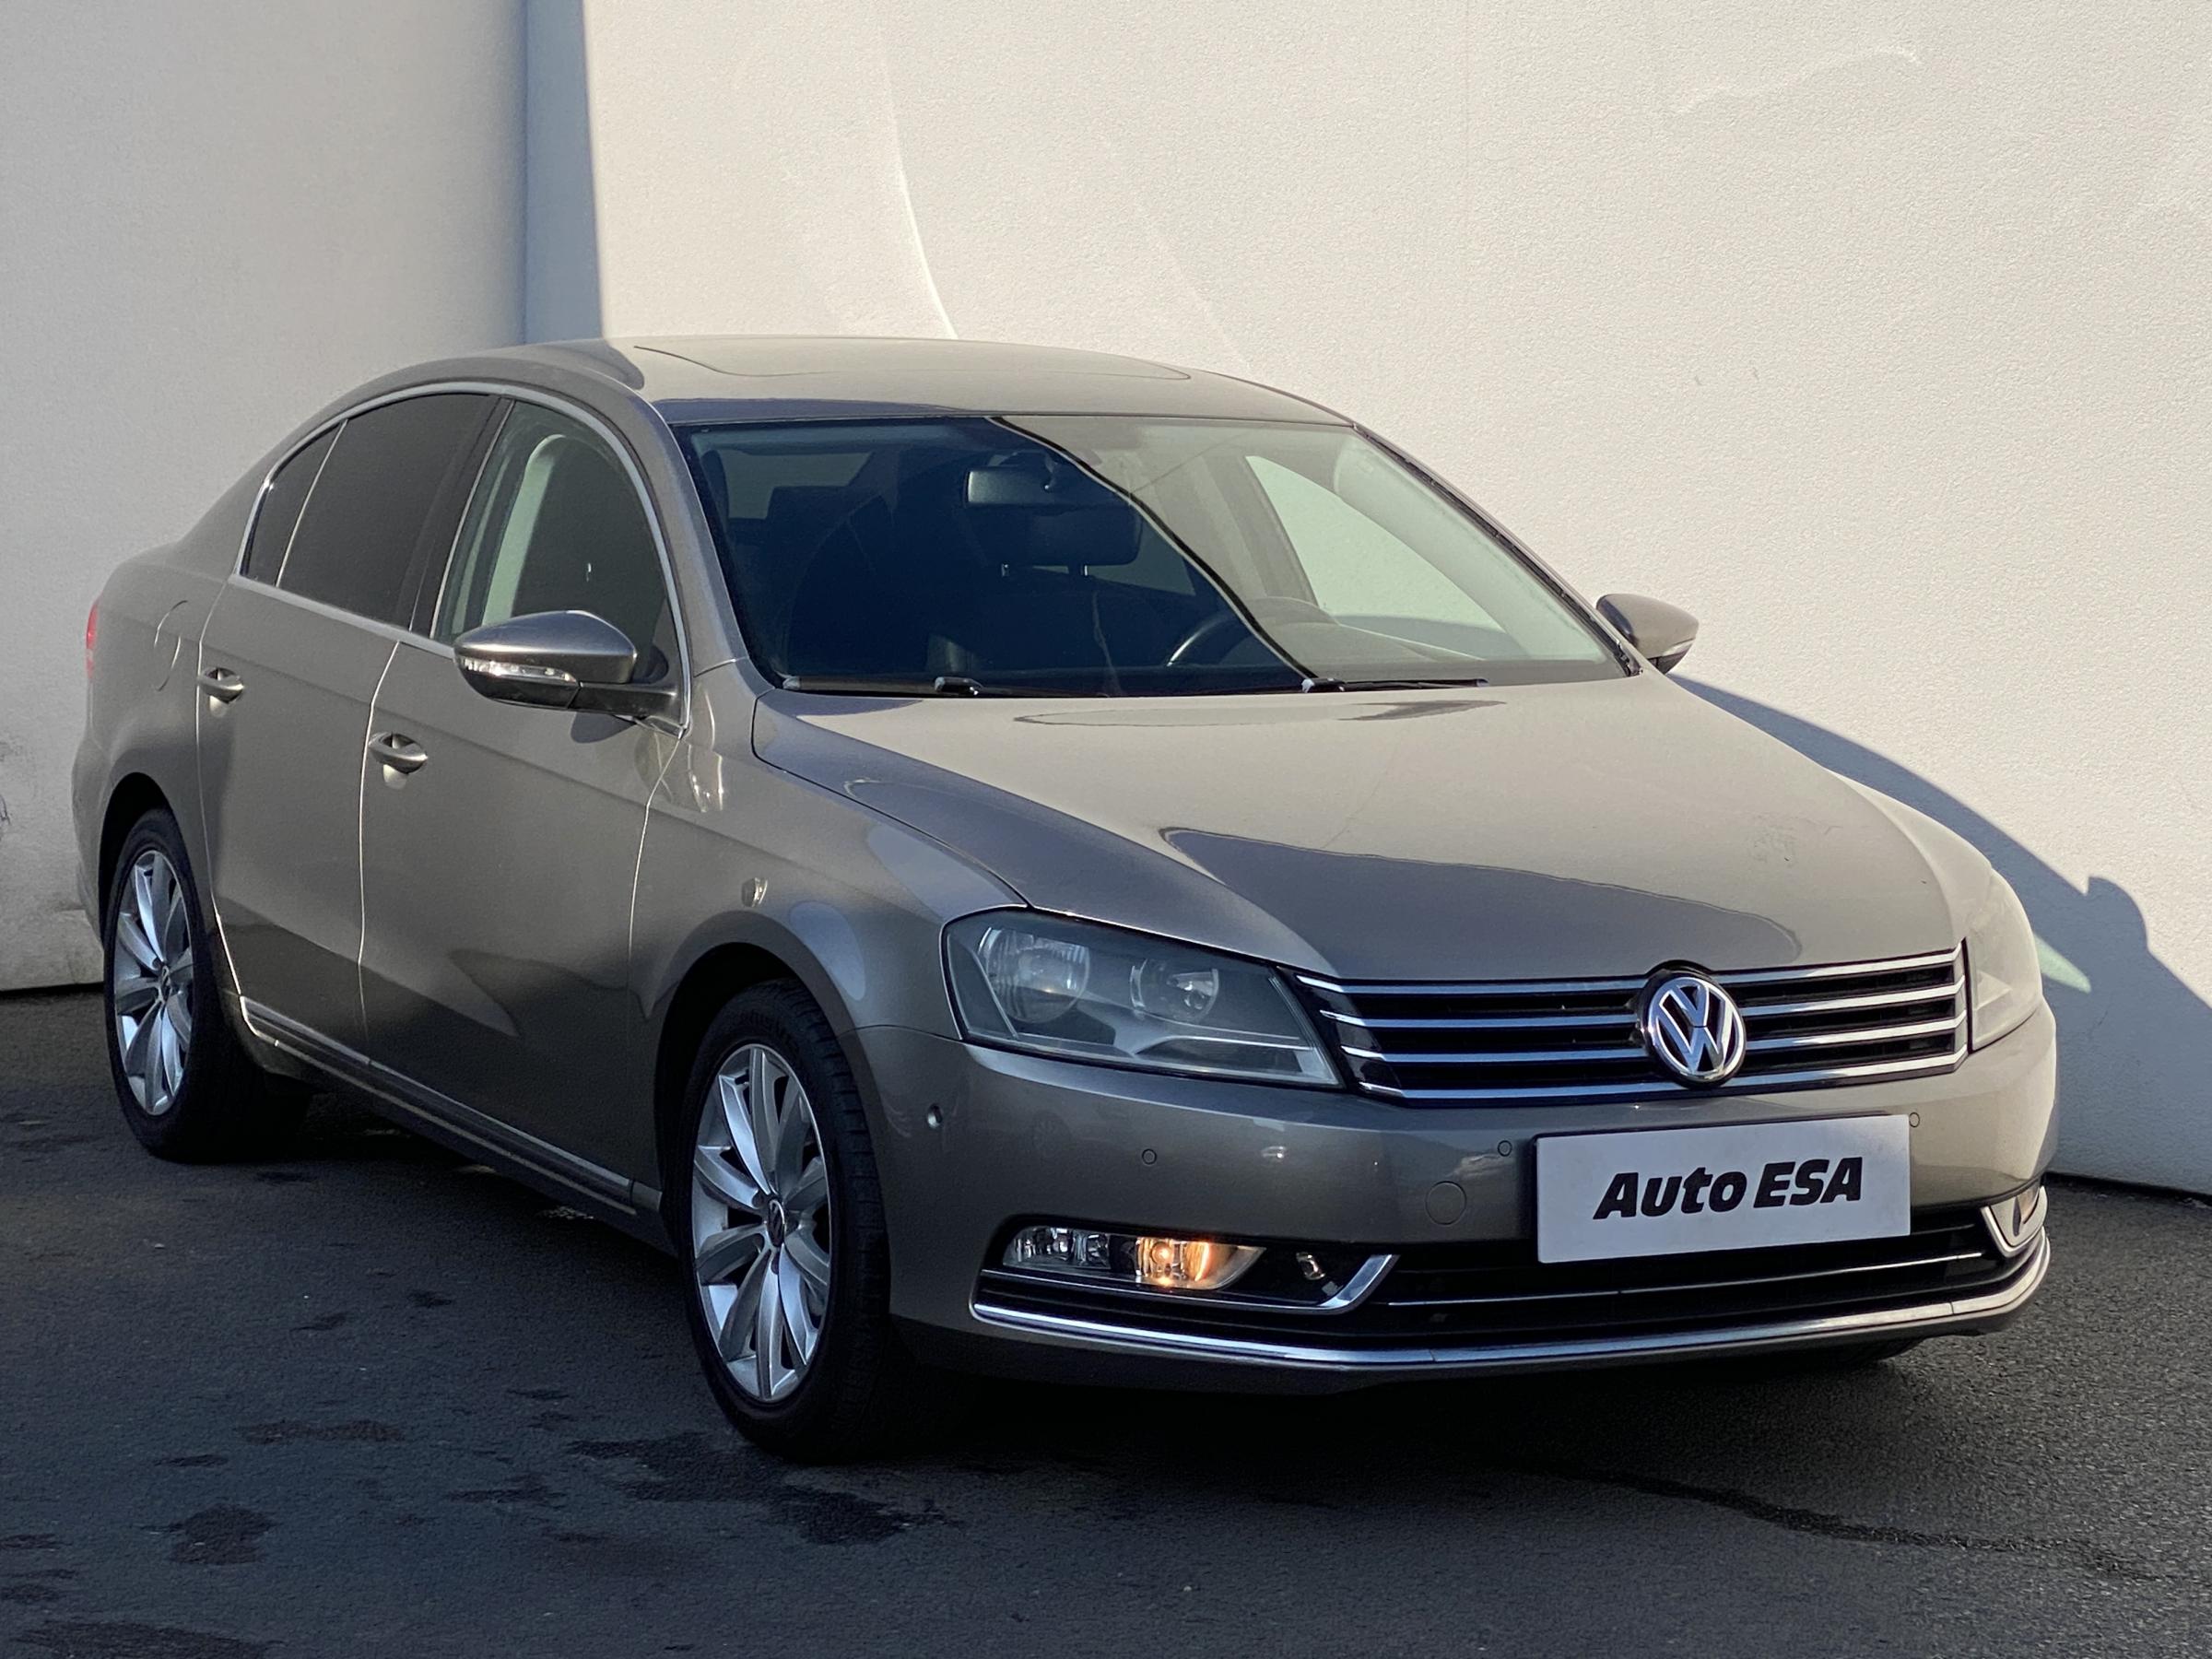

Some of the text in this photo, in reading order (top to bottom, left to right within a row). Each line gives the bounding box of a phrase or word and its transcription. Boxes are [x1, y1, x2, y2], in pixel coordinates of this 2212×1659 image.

[1649, 977, 1745, 1081] VW
[1593, 1157, 1863, 1219] Auto ESA
